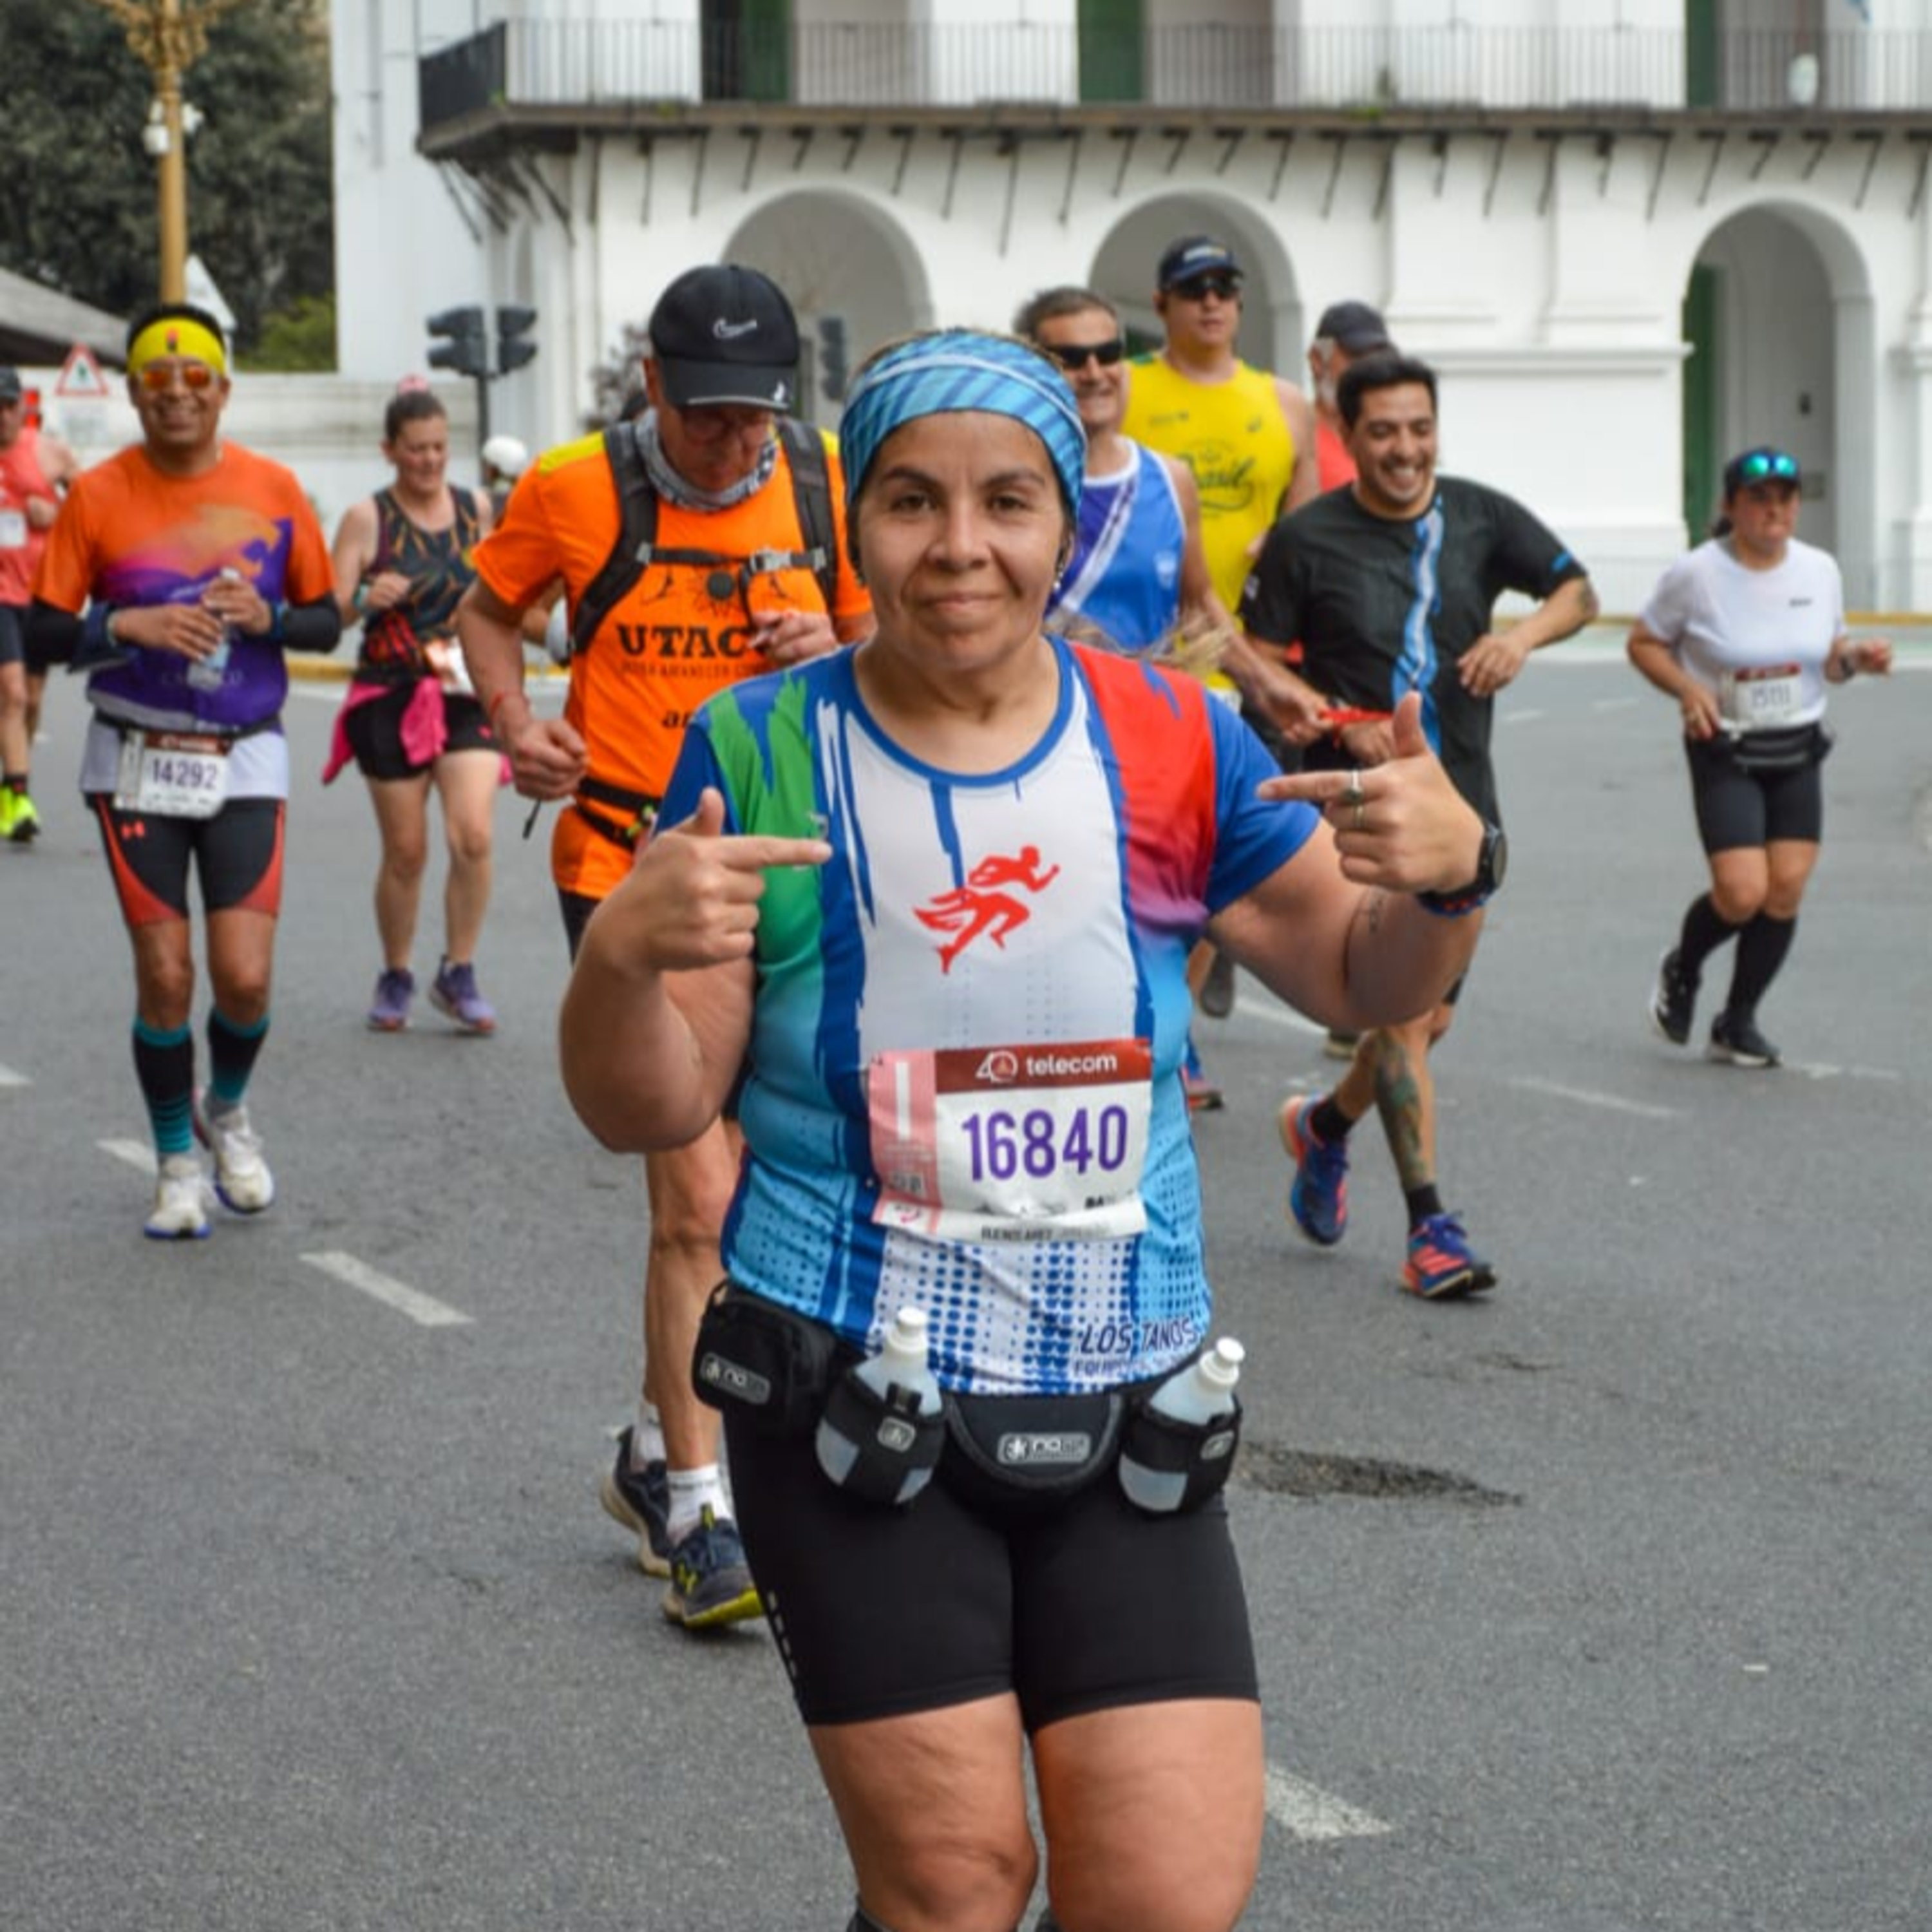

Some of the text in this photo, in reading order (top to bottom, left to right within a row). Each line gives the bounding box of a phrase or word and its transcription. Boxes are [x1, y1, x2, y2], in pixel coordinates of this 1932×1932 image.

[153, 757, 218, 790] 14292
[1026, 1053, 1118, 1077] telecom
[961, 1104, 1128, 1182] 16840
[1080, 1324, 1132, 1354] LOS
